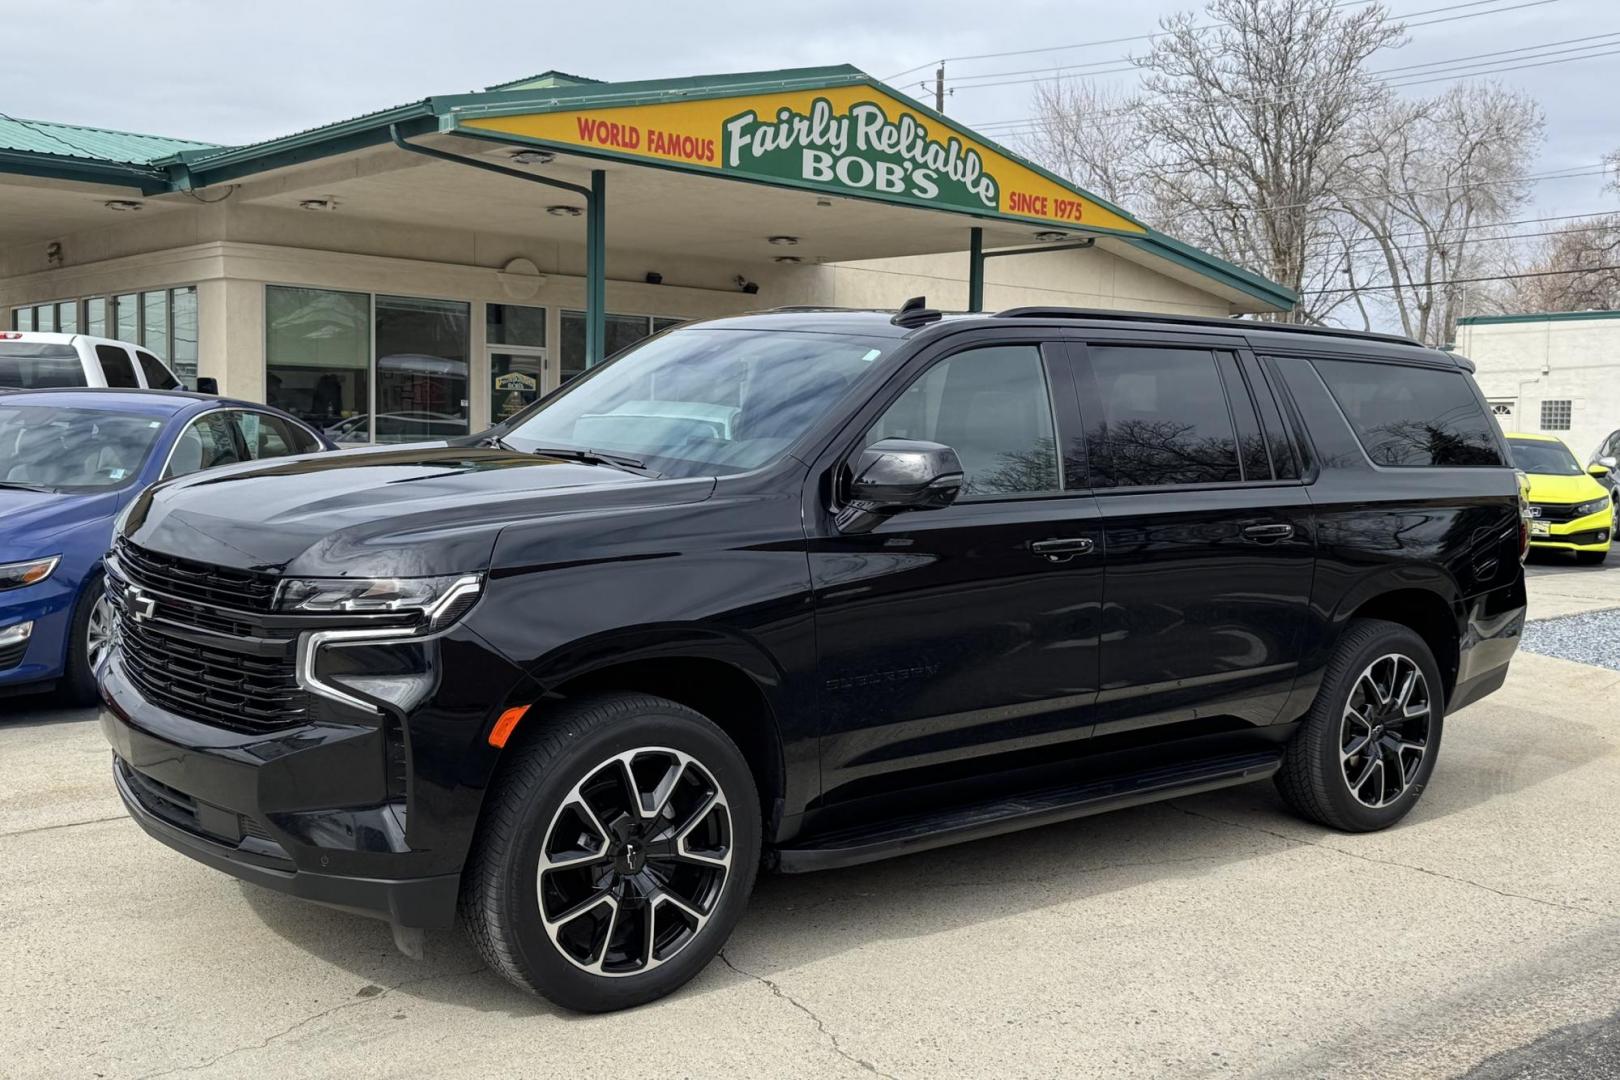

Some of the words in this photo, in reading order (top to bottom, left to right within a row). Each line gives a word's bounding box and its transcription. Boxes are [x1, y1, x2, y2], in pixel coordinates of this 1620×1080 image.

[576, 116, 640, 149] WORLD
[647, 129, 714, 162] FAMOUS
[727, 101, 848, 167] Fairly
[852, 105, 997, 207] Reliable
[802, 149, 940, 199] BOB'S
[1009, 191, 1048, 216] SINCE
[1053, 199, 1083, 221] 1975
